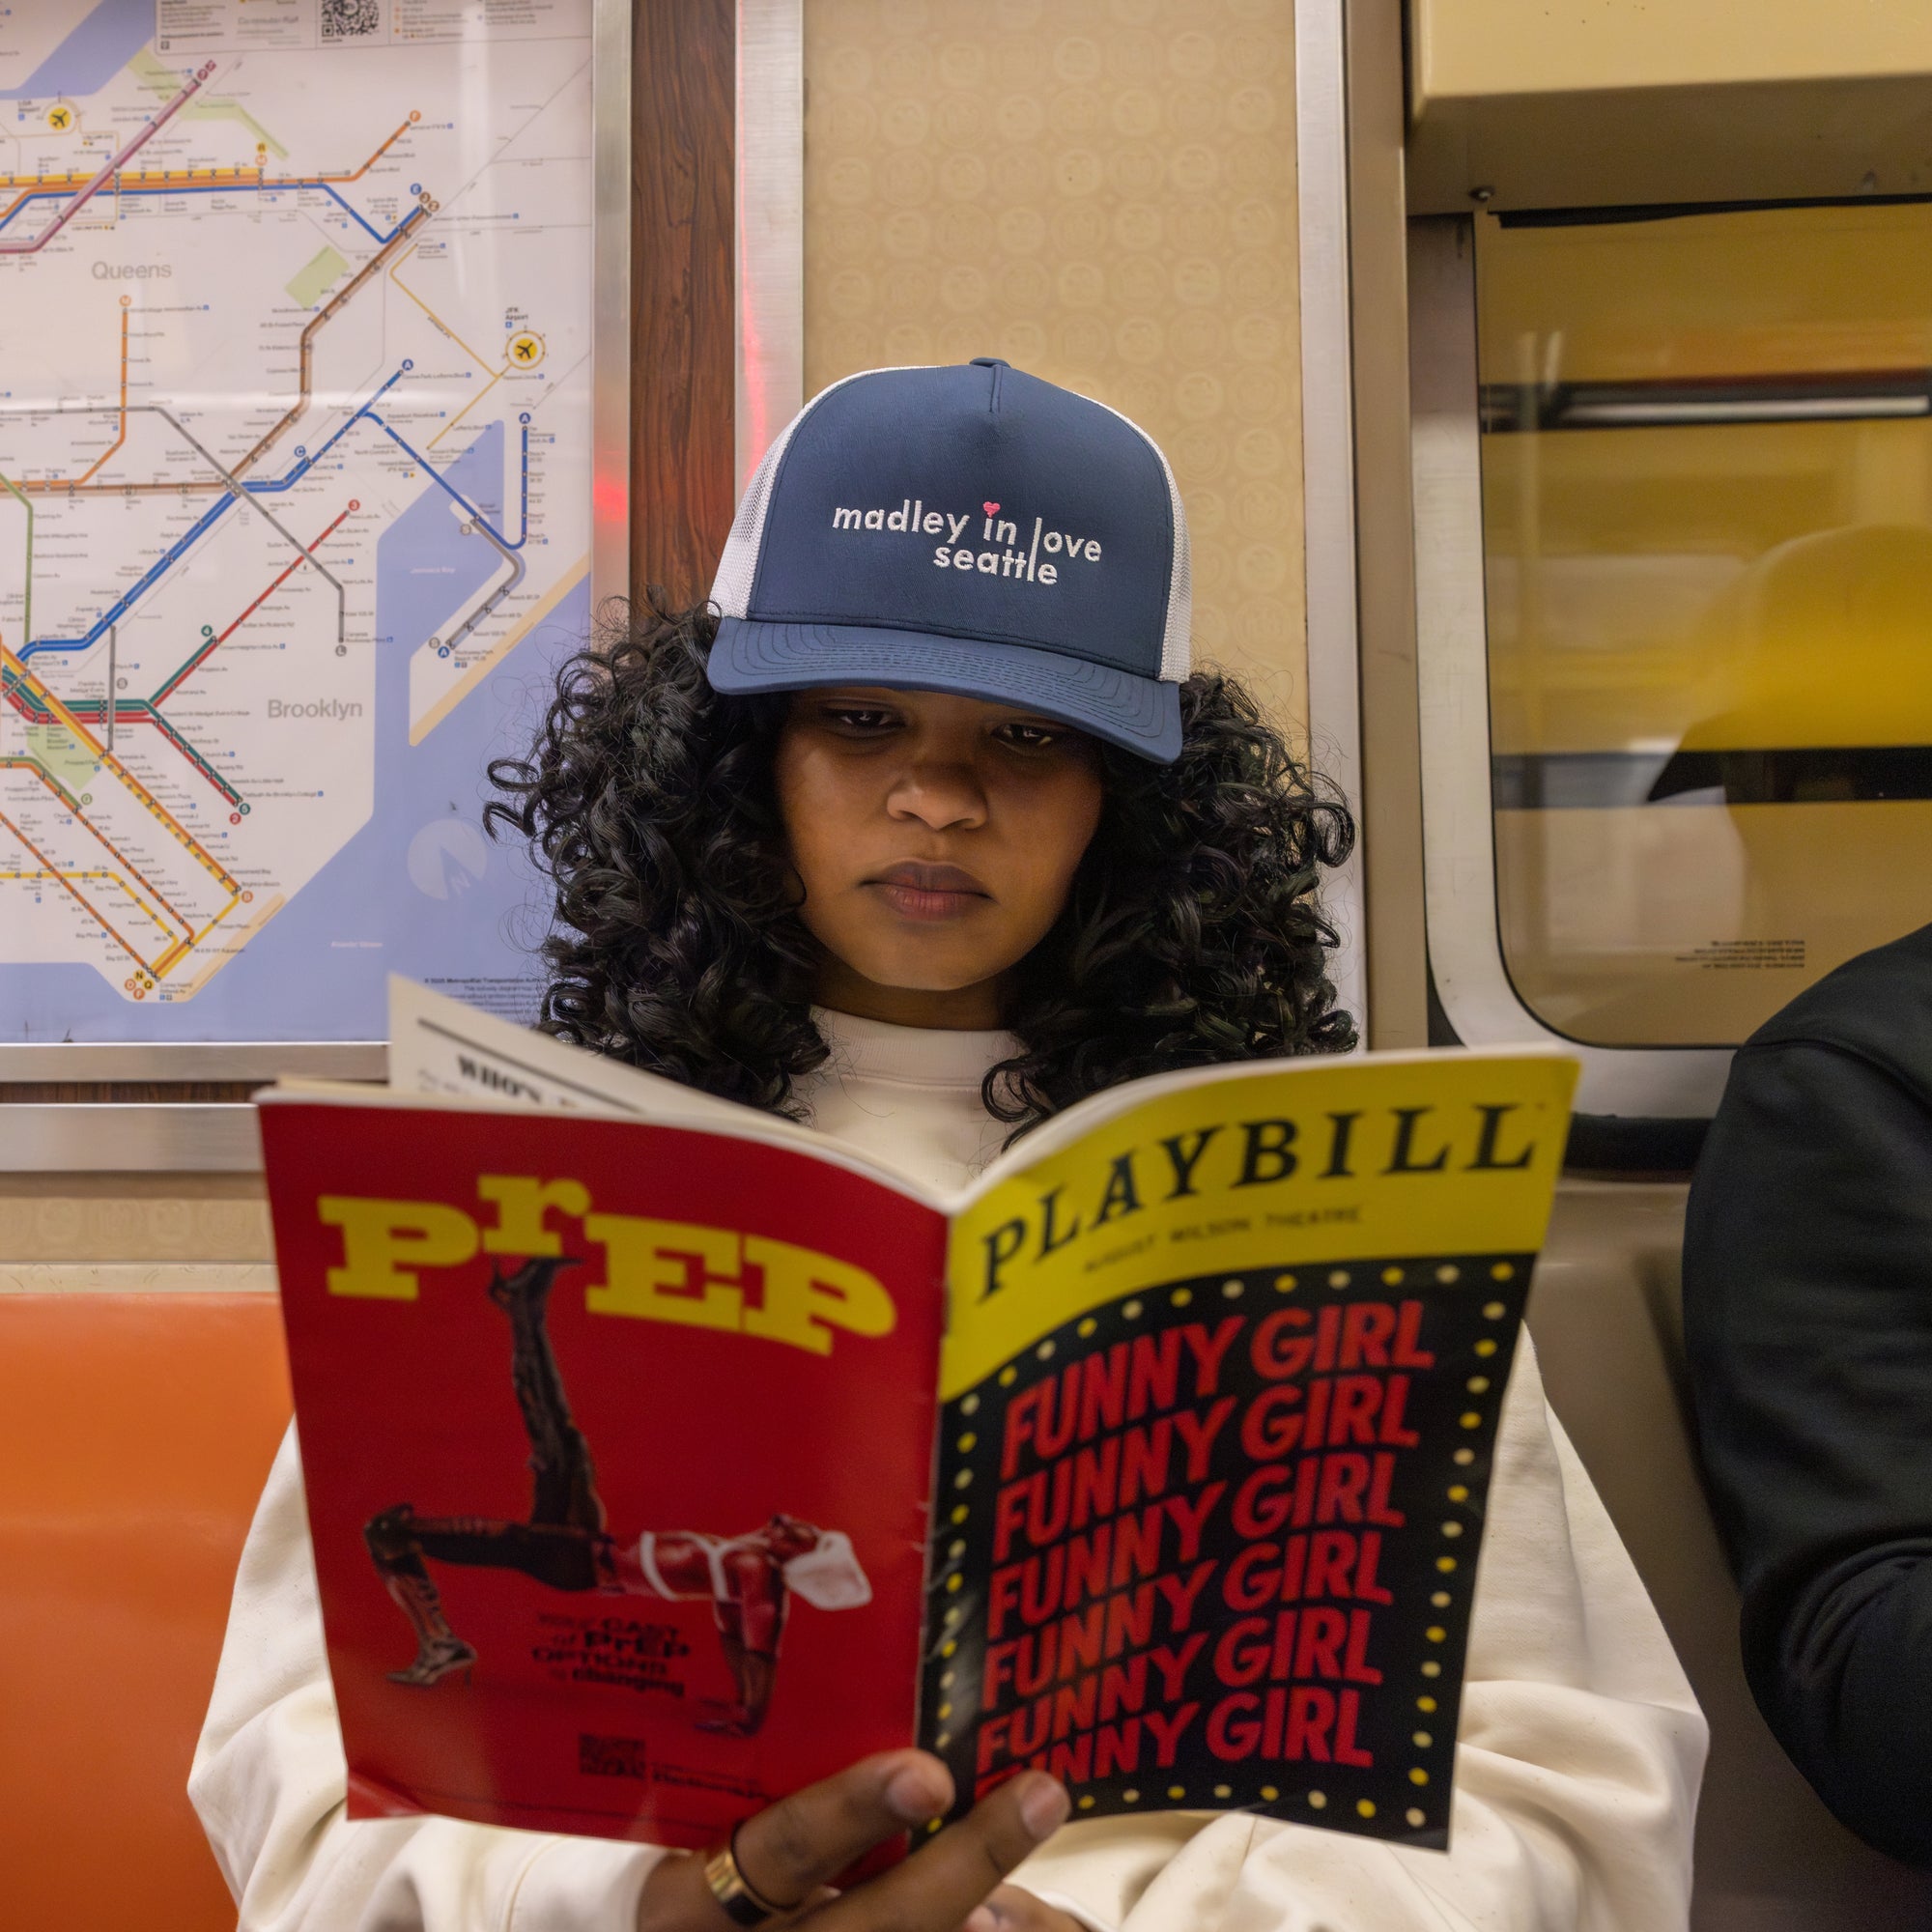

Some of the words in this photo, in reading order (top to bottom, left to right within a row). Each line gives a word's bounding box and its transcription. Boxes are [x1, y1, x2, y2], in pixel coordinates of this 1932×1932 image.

[91, 261, 173, 280] Queens
[831, 498, 970, 545] madley
[982, 500, 1017, 546] in
[1026, 516, 1102, 582] love
[932, 526, 1059, 585] seattle
[267, 696, 363, 722] Brooklyn
[318, 1175, 896, 1355] PrEP
[977, 1101, 1539, 1305] PLAYBILL
[1169, 1216, 1252, 1245] WILSON
[1264, 1205, 1363, 1230] THEATRE
[992, 1395, 1239, 1564] FUNNY
[1240, 1375, 1420, 1462] GIRL
[1000, 1315, 1248, 1483] FUNNY
[1250, 1300, 1435, 1380] GIRL
[981, 1558, 1219, 1712] FUNNY
[1222, 1529, 1394, 1613] GIRL
[986, 1480, 1228, 1641] FUNNY
[1231, 1452, 1406, 1540] GIRL
[976, 1632, 1209, 1775] FUNNY
[1212, 1605, 1383, 1689] GIRL
[1205, 1686, 1374, 1769] GIRL
